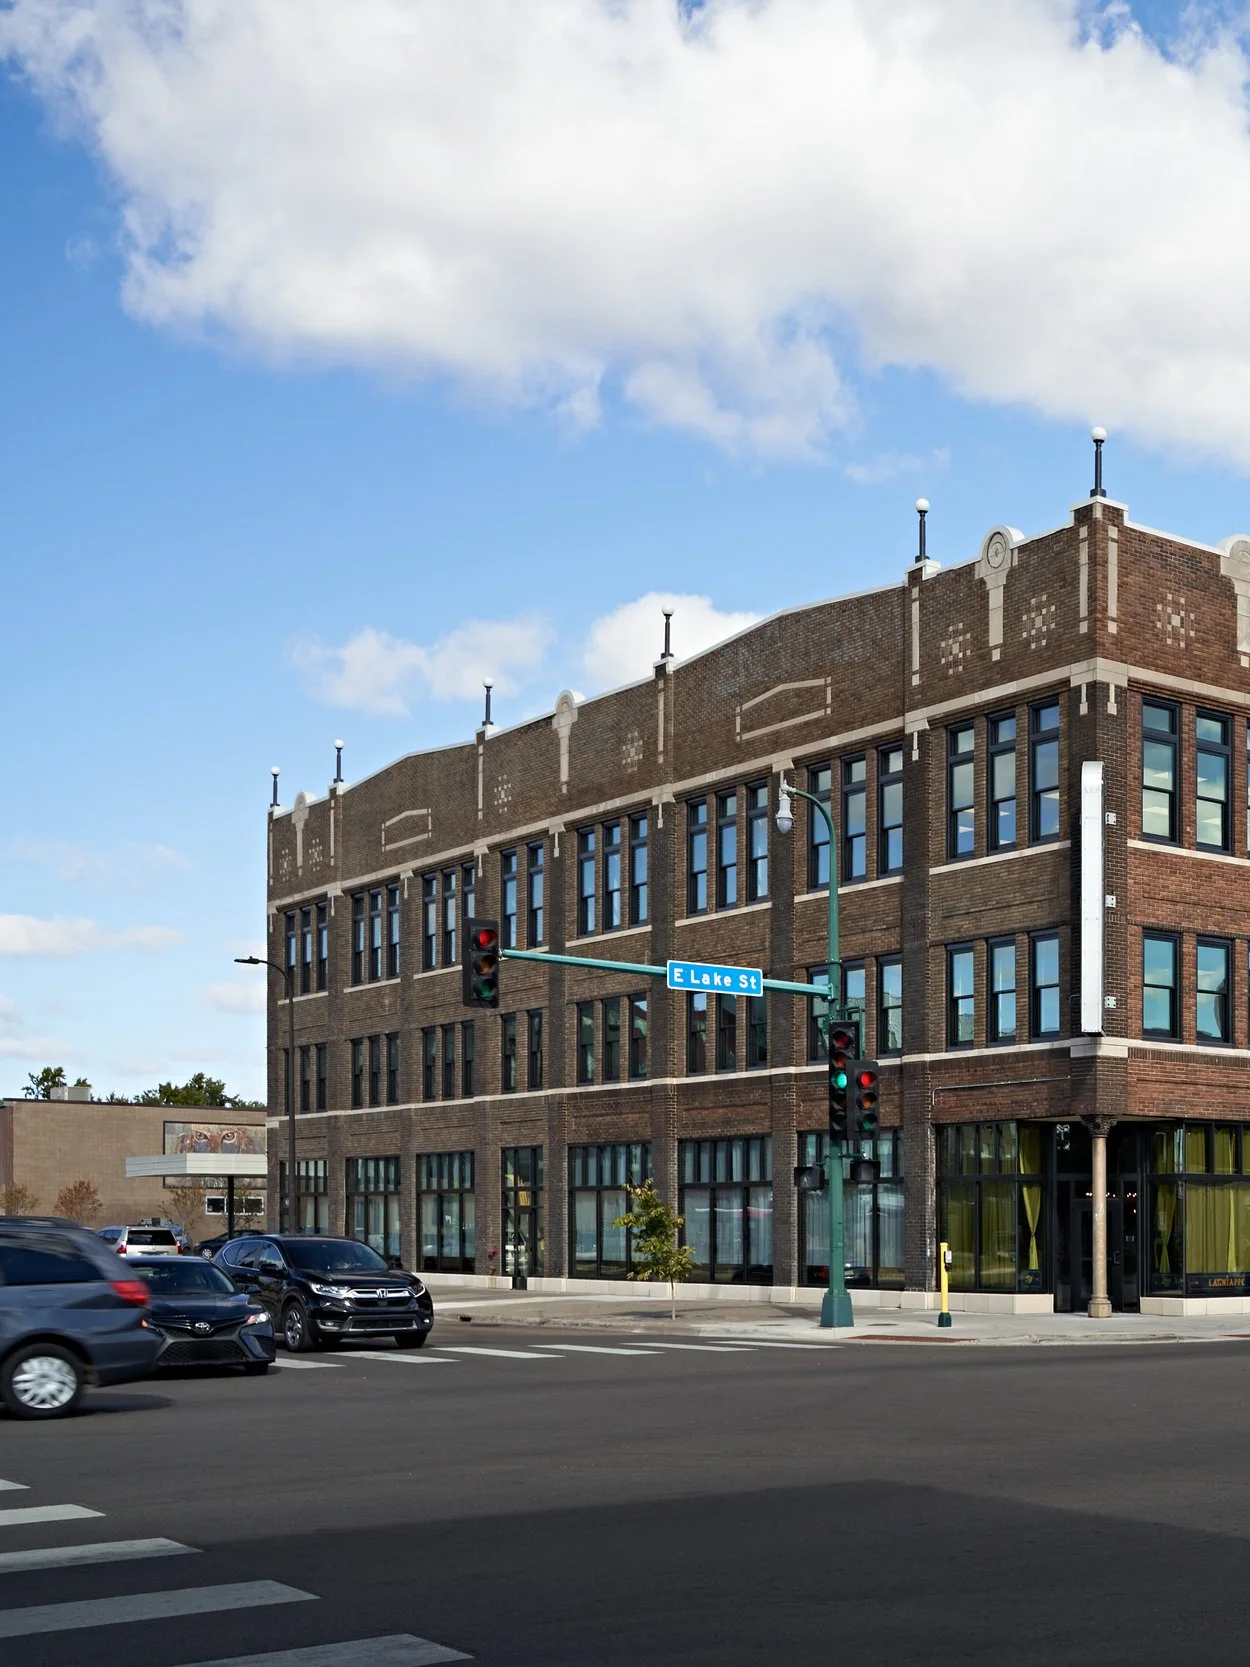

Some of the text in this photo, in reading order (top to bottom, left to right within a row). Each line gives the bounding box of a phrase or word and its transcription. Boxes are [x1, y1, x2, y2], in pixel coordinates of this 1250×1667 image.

[673, 968, 757, 990] E Lake St
